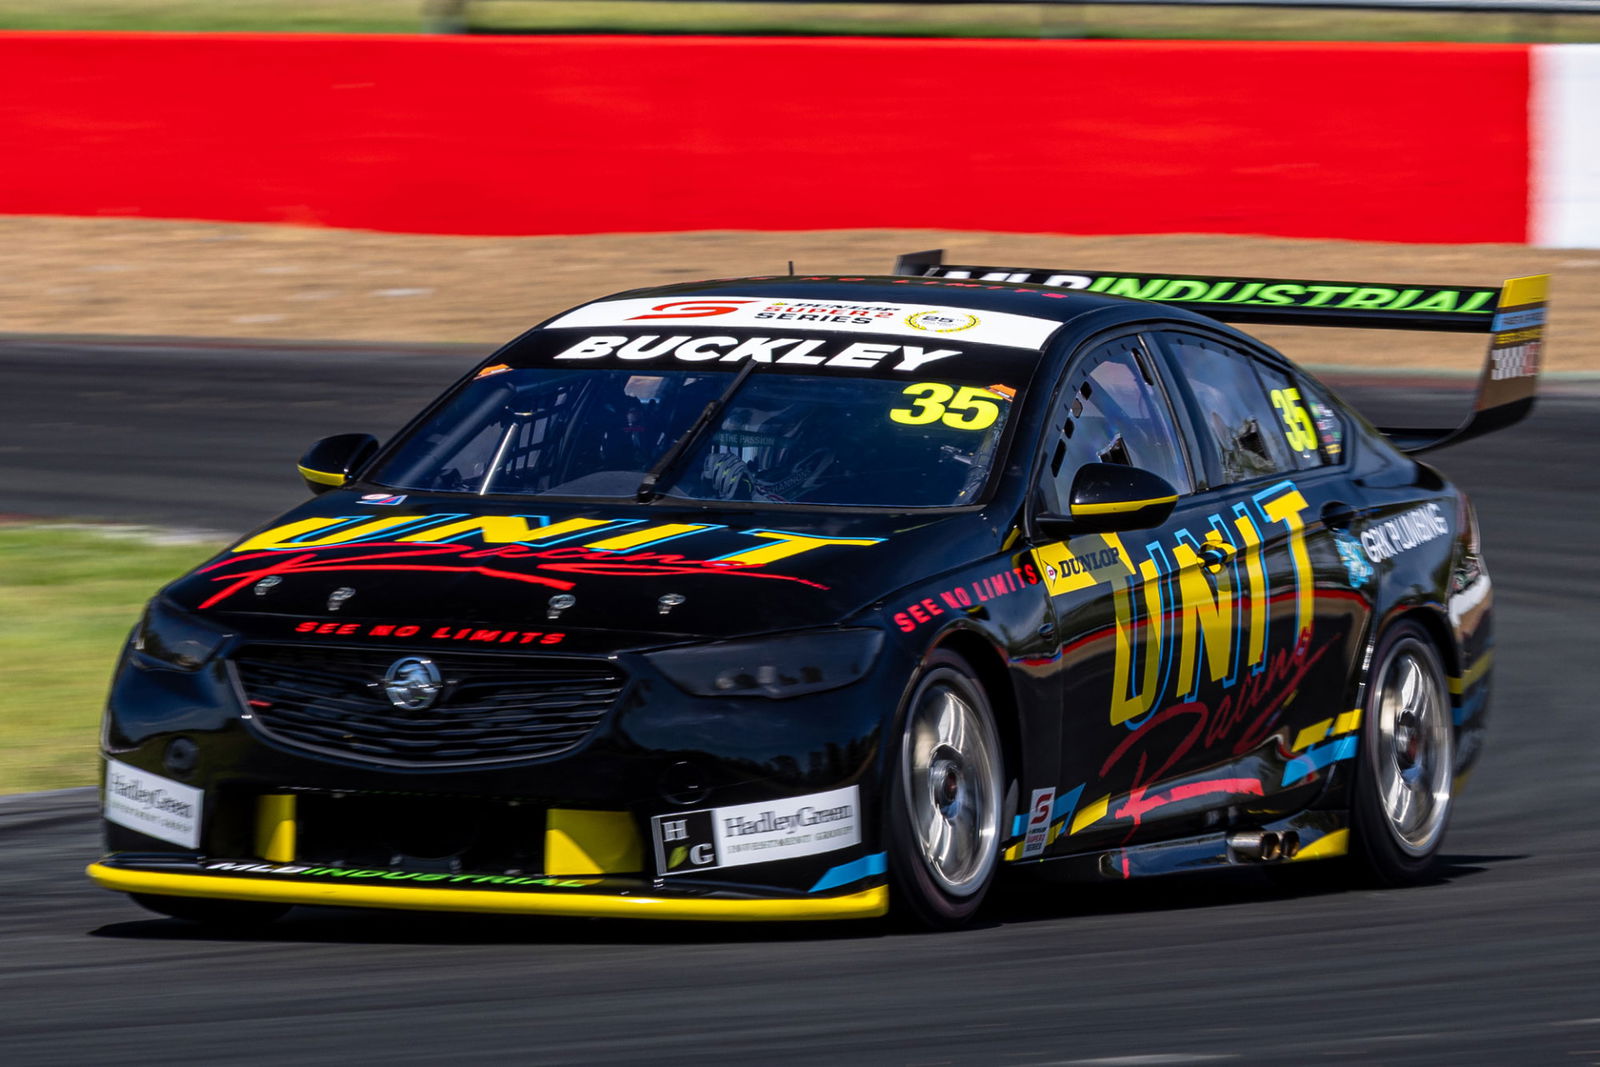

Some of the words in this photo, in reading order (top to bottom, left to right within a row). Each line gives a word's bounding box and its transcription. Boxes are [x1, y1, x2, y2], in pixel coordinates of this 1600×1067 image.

[754, 312, 874, 325] SERIES
[554, 334, 963, 372] BUCKLEY
[889, 382, 1000, 431] 35
[1270, 387, 1319, 452] 35
[231, 513, 889, 569] UNIT
[1058, 547, 1121, 579] DUNLOP
[893, 598, 945, 634] SEE
[940, 586, 972, 610] NO
[972, 563, 1039, 602] LIMITS
[1109, 480, 1315, 730] UNIT
[295, 621, 362, 636] SEE
[368, 624, 421, 637] NO
[431, 626, 567, 645] LIMITS
[661, 818, 690, 843] H
[689, 843, 715, 866] G
